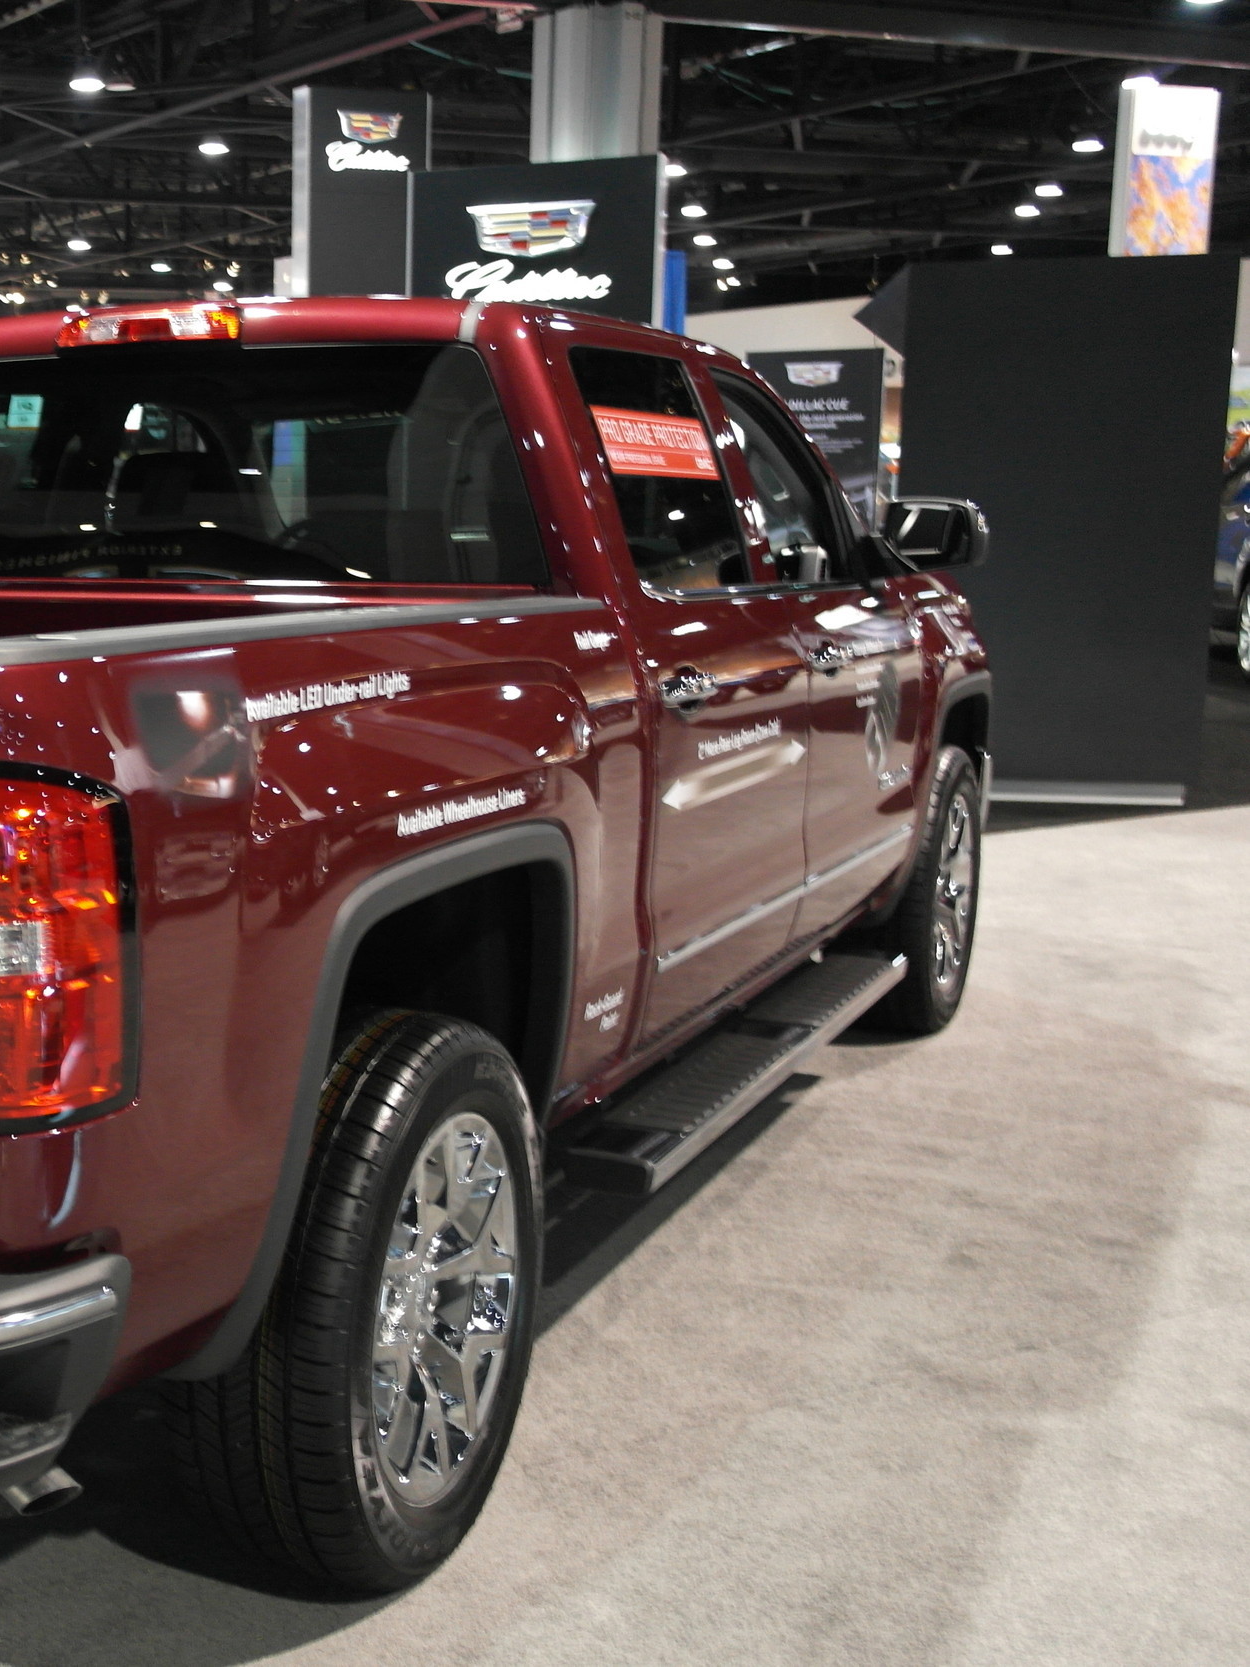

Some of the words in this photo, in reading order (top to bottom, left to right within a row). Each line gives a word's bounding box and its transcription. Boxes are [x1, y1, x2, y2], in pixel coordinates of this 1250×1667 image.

[445, 258, 612, 303] Cadillac
[597, 417, 625, 443] PRO
[619, 419, 657, 446] GRADE
[651, 423, 709, 452] PROTECTION
[245, 690, 300, 722] Available
[300, 682, 325, 711] LED
[324, 674, 377, 707] Under-rail
[377, 670, 411, 699] Lights
[397, 804, 444, 837] Available
[443, 795, 499, 825] Wheelhouse
[498, 787, 526, 810] Liners
